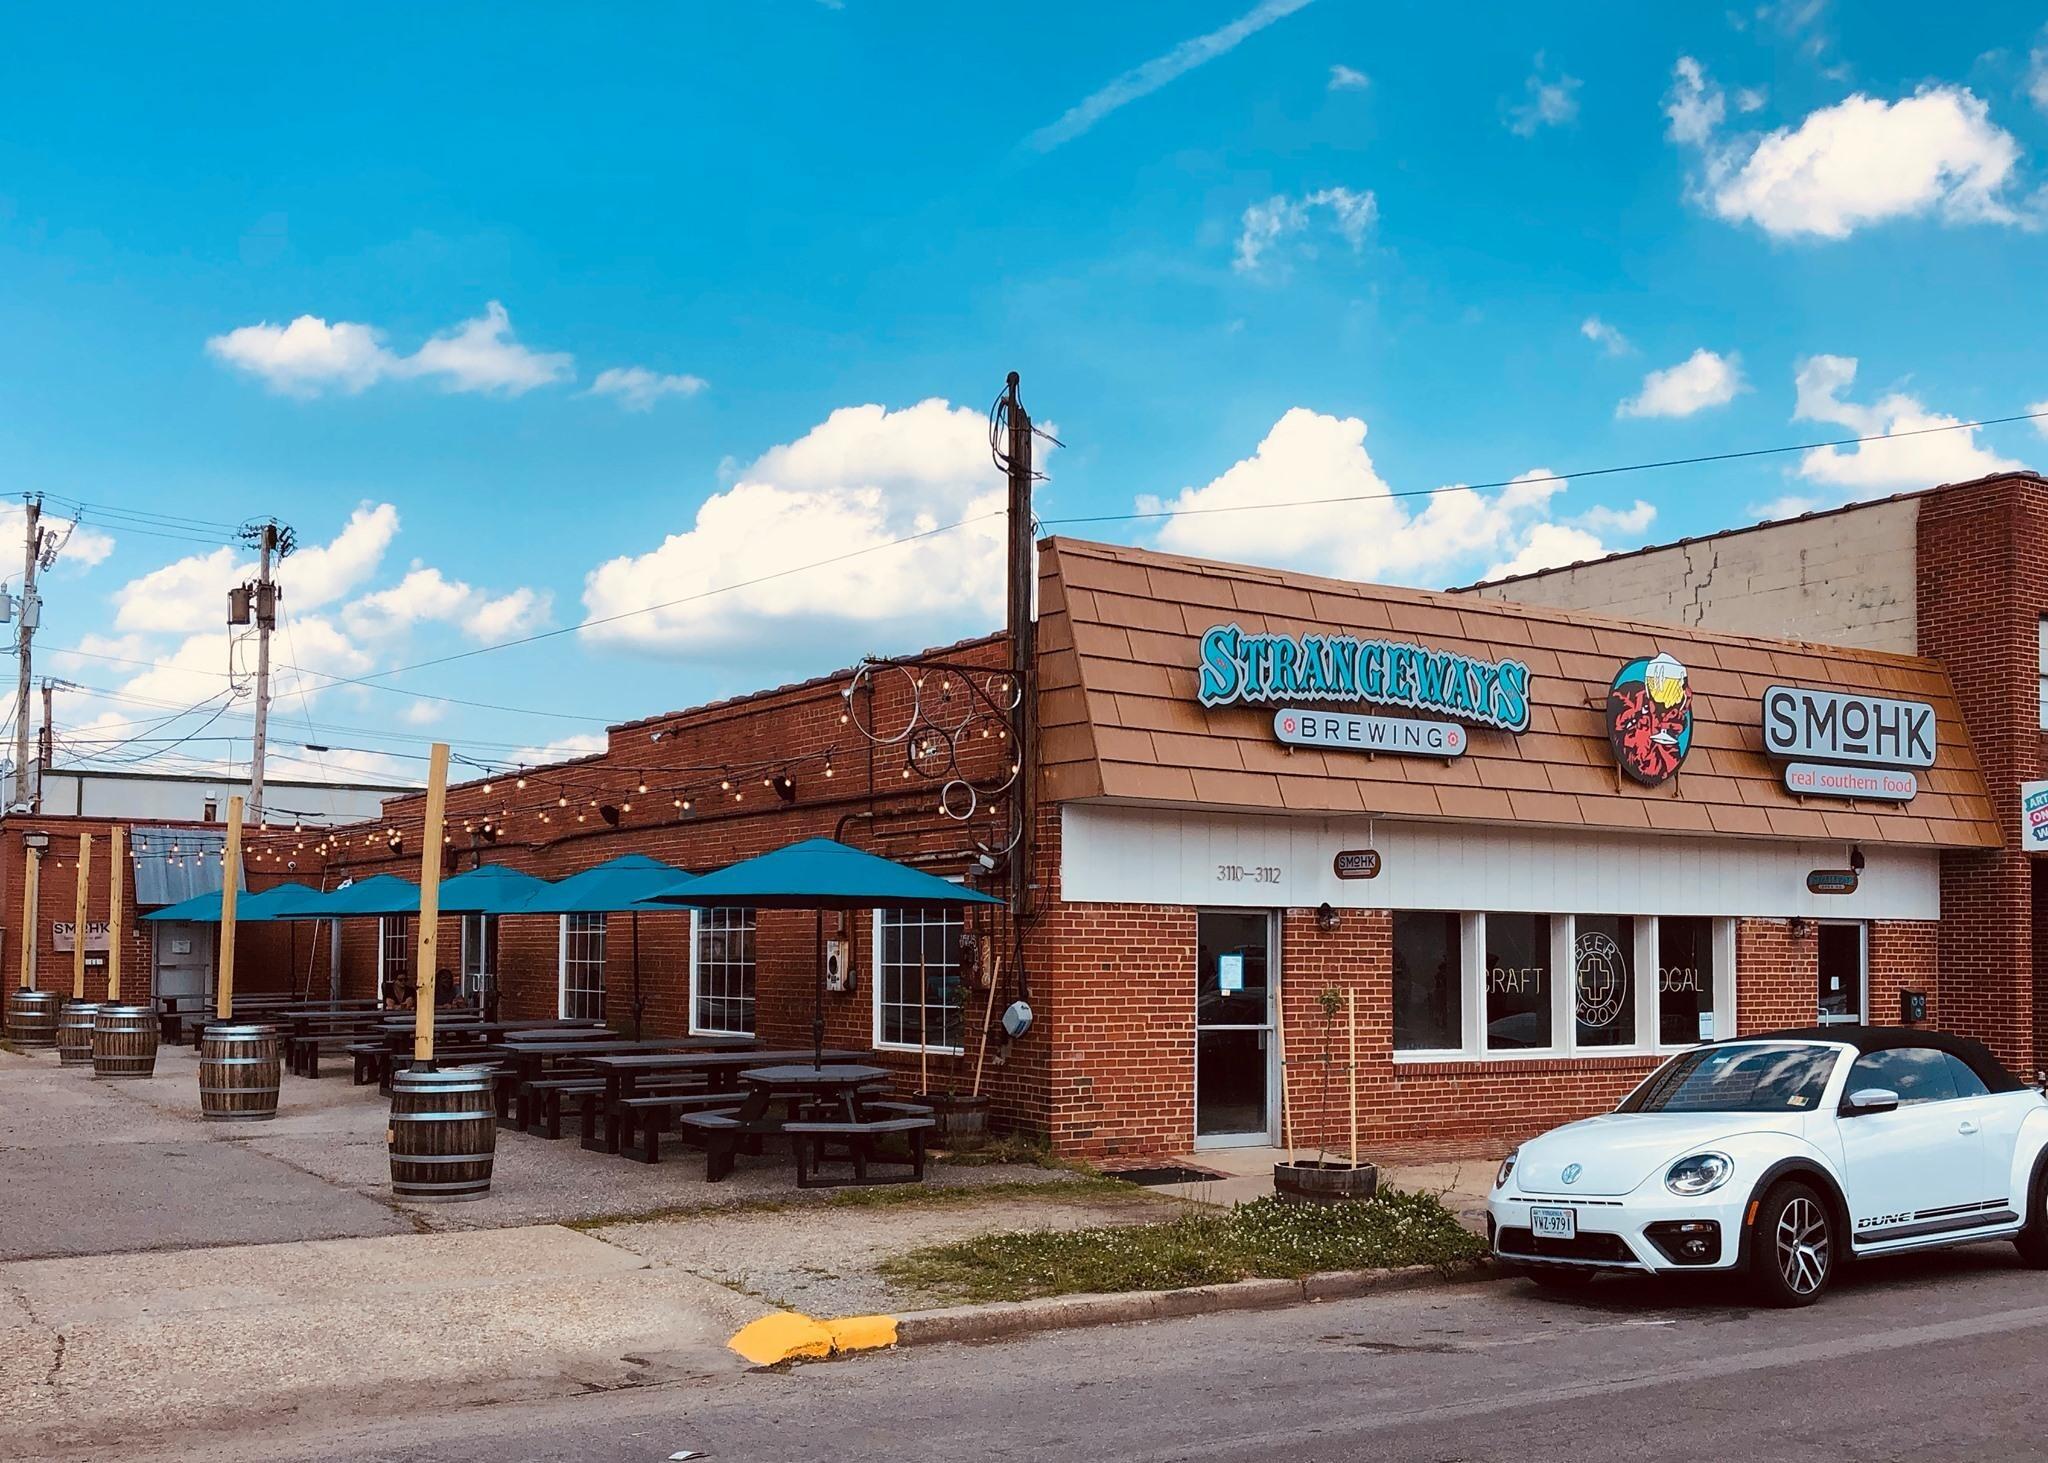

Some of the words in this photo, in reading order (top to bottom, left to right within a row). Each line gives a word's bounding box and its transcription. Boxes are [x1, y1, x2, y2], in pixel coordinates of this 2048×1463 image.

[1201, 628, 1528, 726] STRANGEWAYS
[1301, 716, 1443, 749] BREWING
[1770, 692, 1932, 760] SMOHK
[1791, 770, 1816, 786] real
[1820, 773, 1878, 791] southern
[1882, 776, 1912, 793] food
[1339, 855, 1375, 868] SMOHK
[1216, 865, 1282, 884] 3110-3112
[54, 923, 110, 935] SMHK
[1577, 999, 1618, 1024] FOOD
[1857, 1212, 1911, 1228] DUNE
